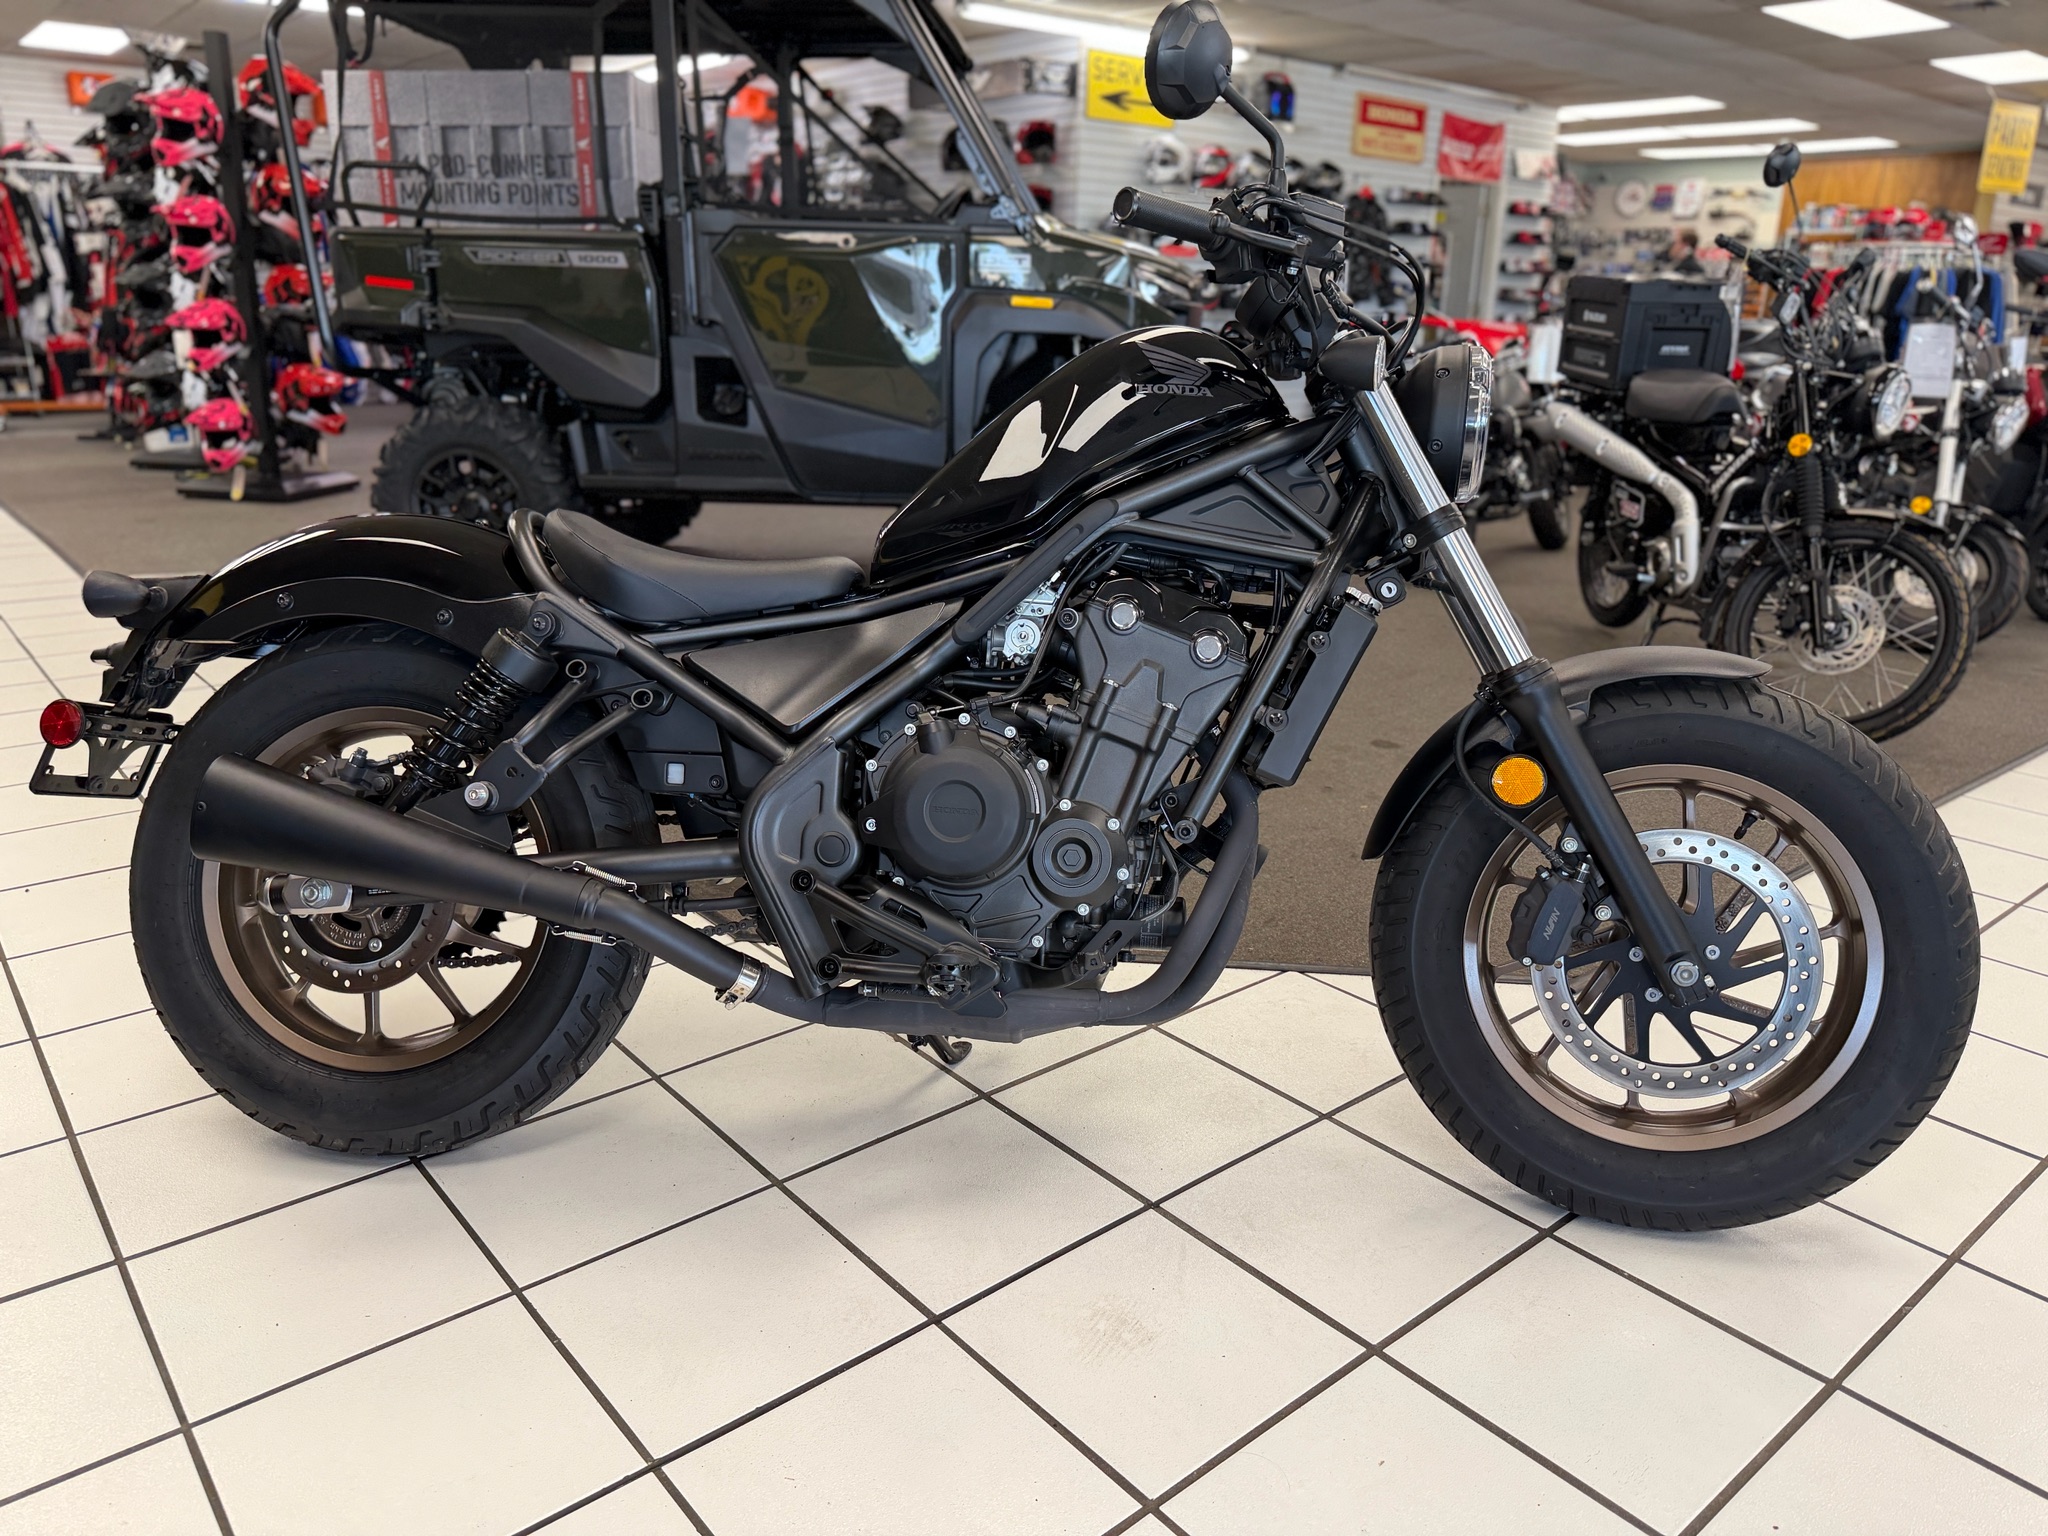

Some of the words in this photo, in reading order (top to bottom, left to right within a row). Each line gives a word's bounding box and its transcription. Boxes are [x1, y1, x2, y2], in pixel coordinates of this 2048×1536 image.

[1093, 56, 1145, 86] SERV
[507, 182, 580, 207] POINTS
[578, 255, 619, 265] 1000
[1135, 384, 1214, 398] HONDA
[932, 805, 980, 817] HONDA
